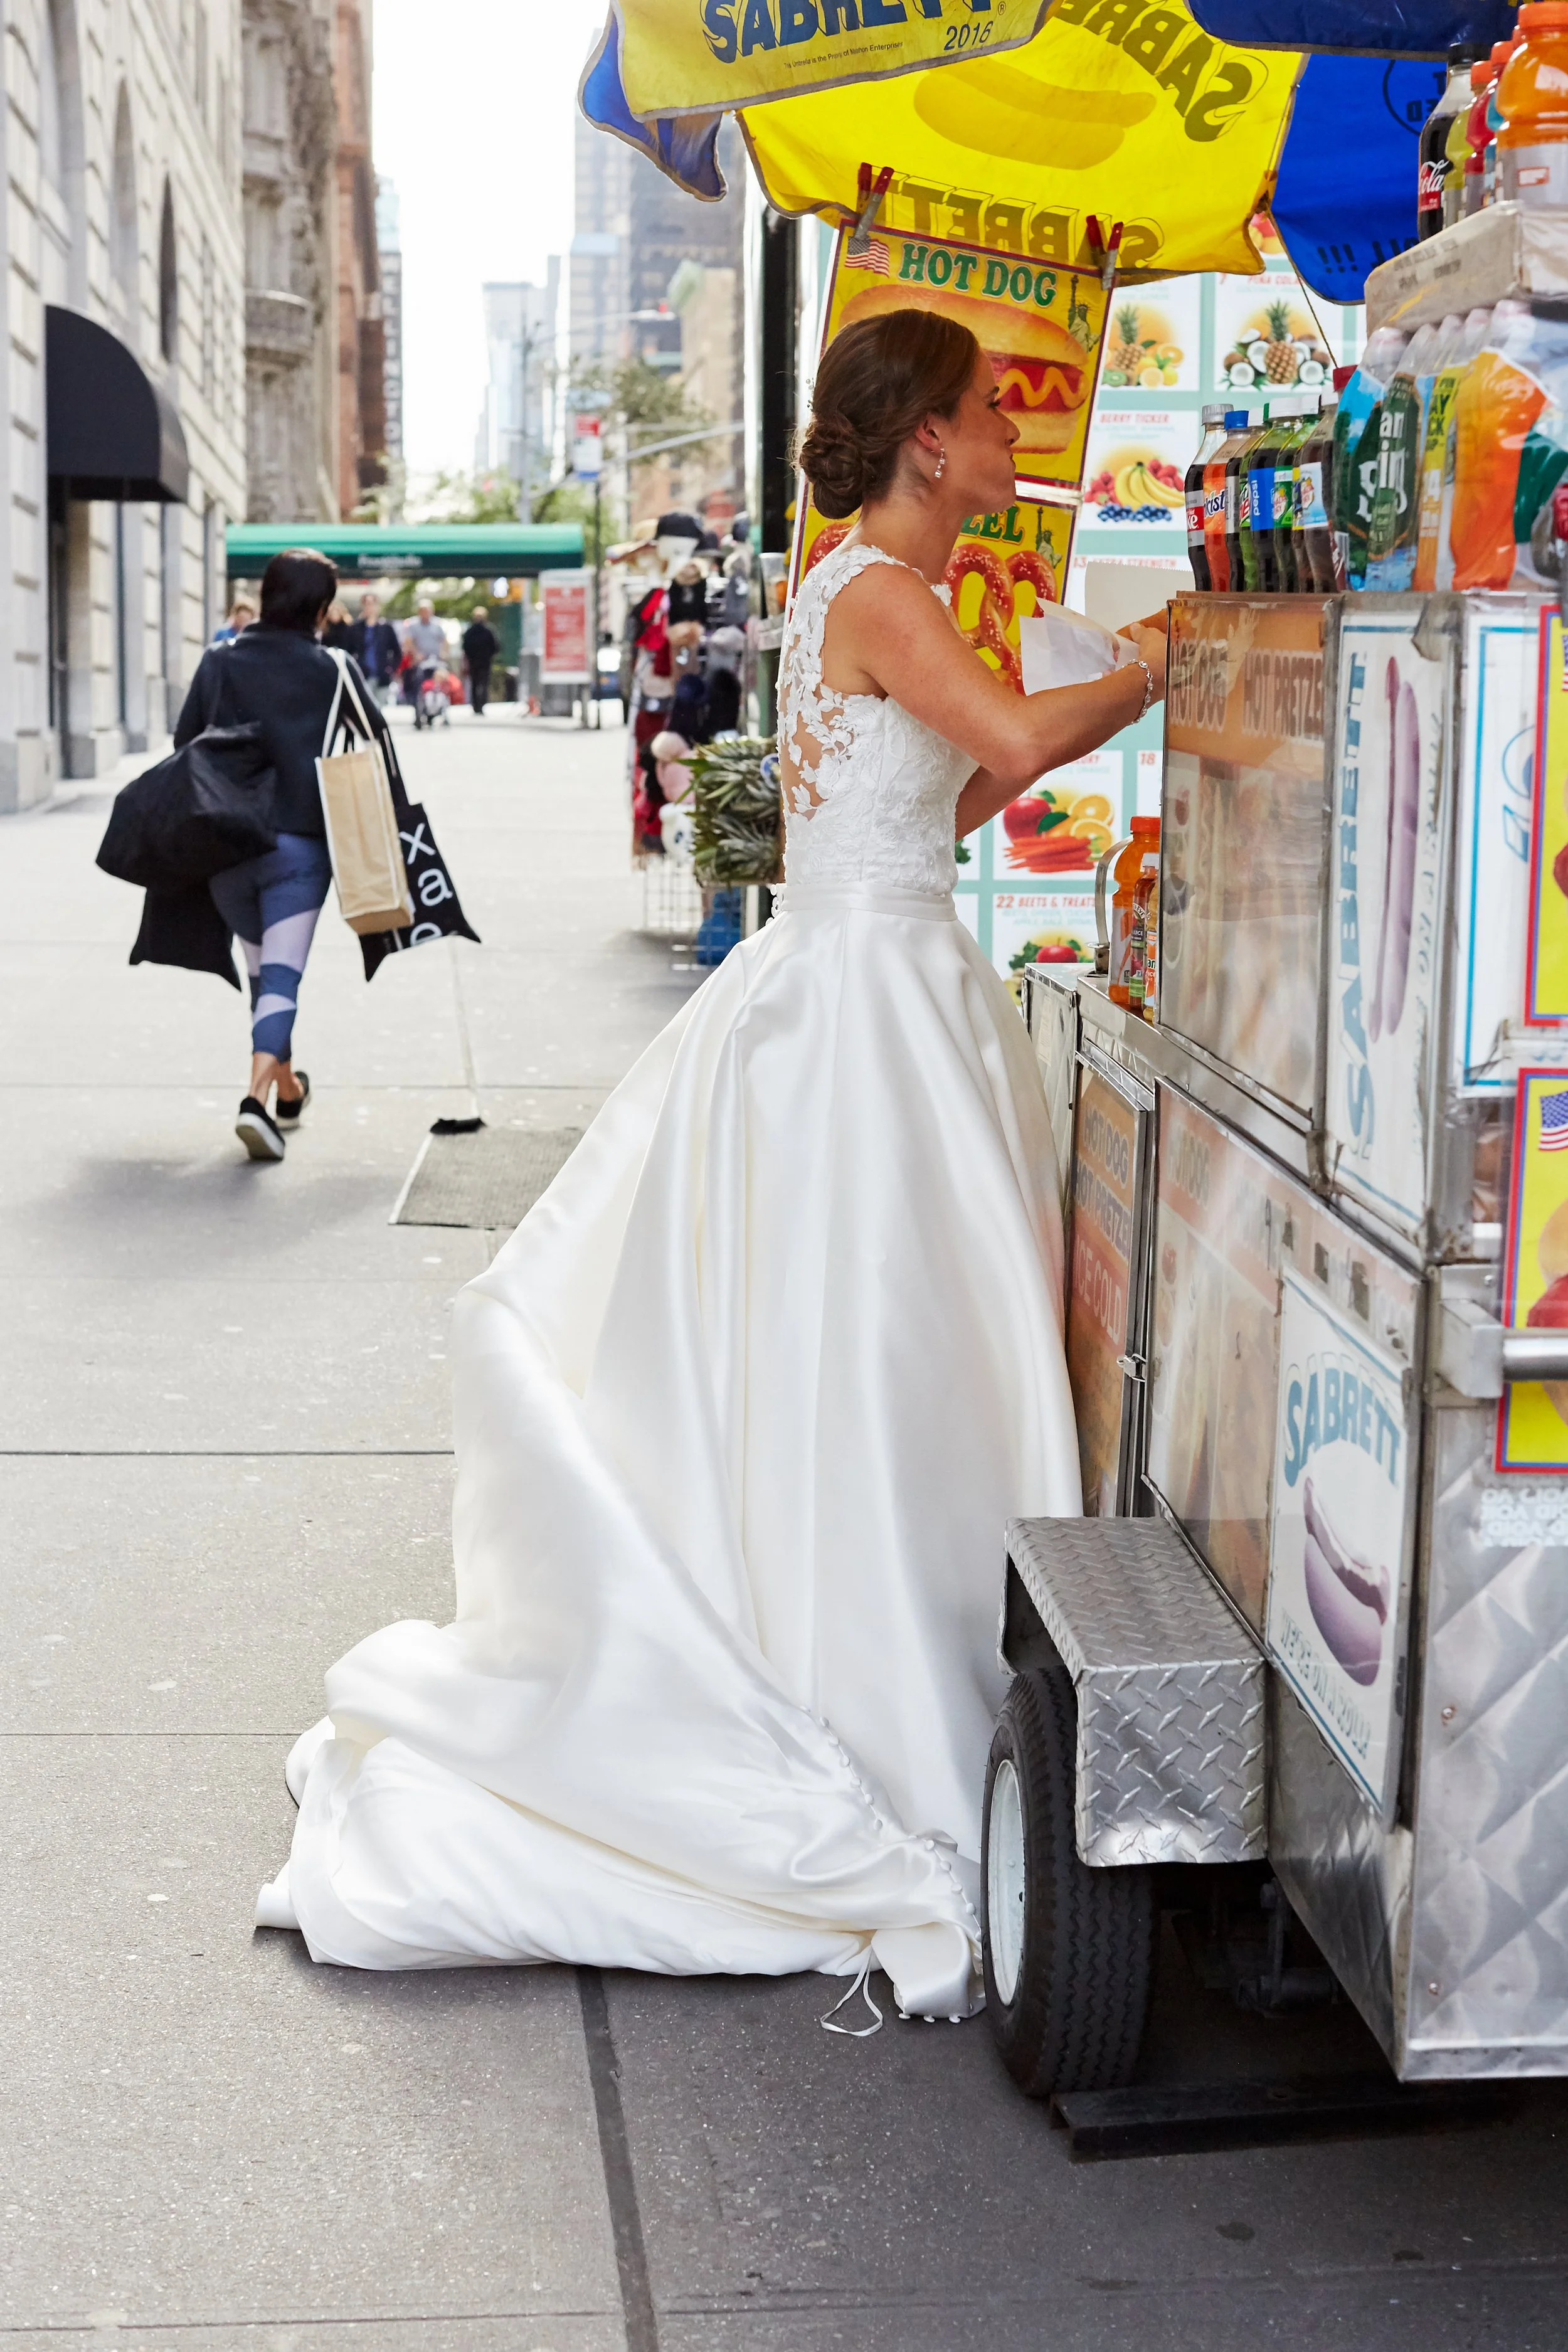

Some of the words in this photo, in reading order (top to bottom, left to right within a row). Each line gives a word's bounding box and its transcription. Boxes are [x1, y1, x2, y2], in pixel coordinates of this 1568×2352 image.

[869, 41, 903, 52] Enterprises
[944, 21, 994, 51] 2016
[899, 241, 978, 292] HOT
[982, 257, 1058, 307] DOG
[1101, 413, 1130, 423] BERRY
[1251, 479, 1261, 516] pepsi
[1242, 649, 1272, 736] HOT
[1140, 753, 1155, 765] 18
[996, 895, 1014, 908] 22
[1019, 897, 1047, 907] BEETS
[1337, 651, 1375, 1160] SABRETT
[1104, 1119, 1129, 1190] DOG
[1074, 1234, 1093, 1306] ICE
[1094, 1259, 1123, 1345] COLD
[1284, 1353, 1402, 1488] SABRETT
